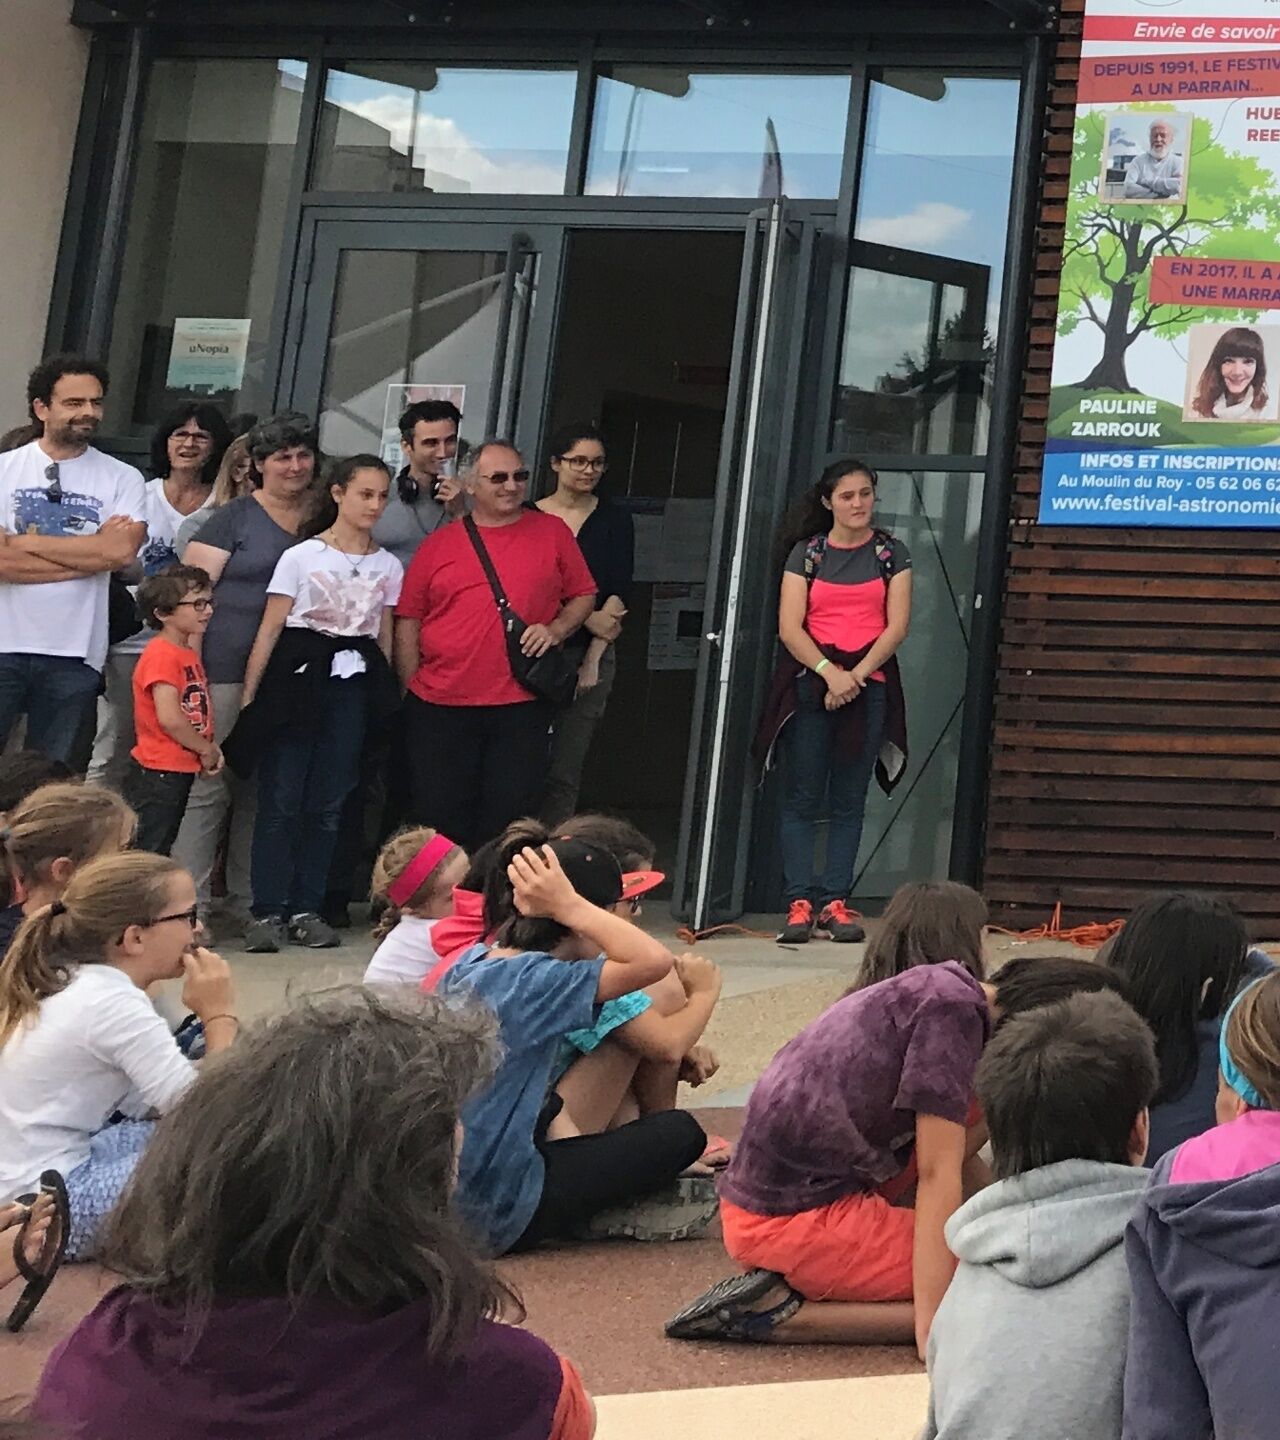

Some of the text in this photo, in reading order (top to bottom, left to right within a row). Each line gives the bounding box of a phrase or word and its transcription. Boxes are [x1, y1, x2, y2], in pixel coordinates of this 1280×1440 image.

[1134, 23, 1279, 39] Envie de savoir
[1094, 62, 1154, 77] DEPUIS
[1160, 61, 1198, 75] 1991,
[1204, 60, 1222, 73] LE
[1131, 83, 1143, 95] A
[1148, 82, 1172, 95] UN
[1171, 263, 1192, 275] EN
[1200, 264, 1237, 278] 2017,
[1243, 266, 1254, 279] IL
[1261, 268, 1272, 280] A
[1182, 286, 1217, 298] UNE
[1080, 400, 1156, 414] PAULINE
[1071, 423, 1161, 437] ZARROUK
[1080, 454, 1134, 468] INFOS
[1138, 454, 1160, 468] ET
[1058, 475, 1078, 486] Au
[1082, 475, 1130, 487] Moulin
[1134, 476, 1153, 488] du
[1156, 476, 1182, 490] Roy
[1196, 478, 1214, 489] 05
[1219, 478, 1238, 490] 62
[1242, 478, 1261, 490] 06
